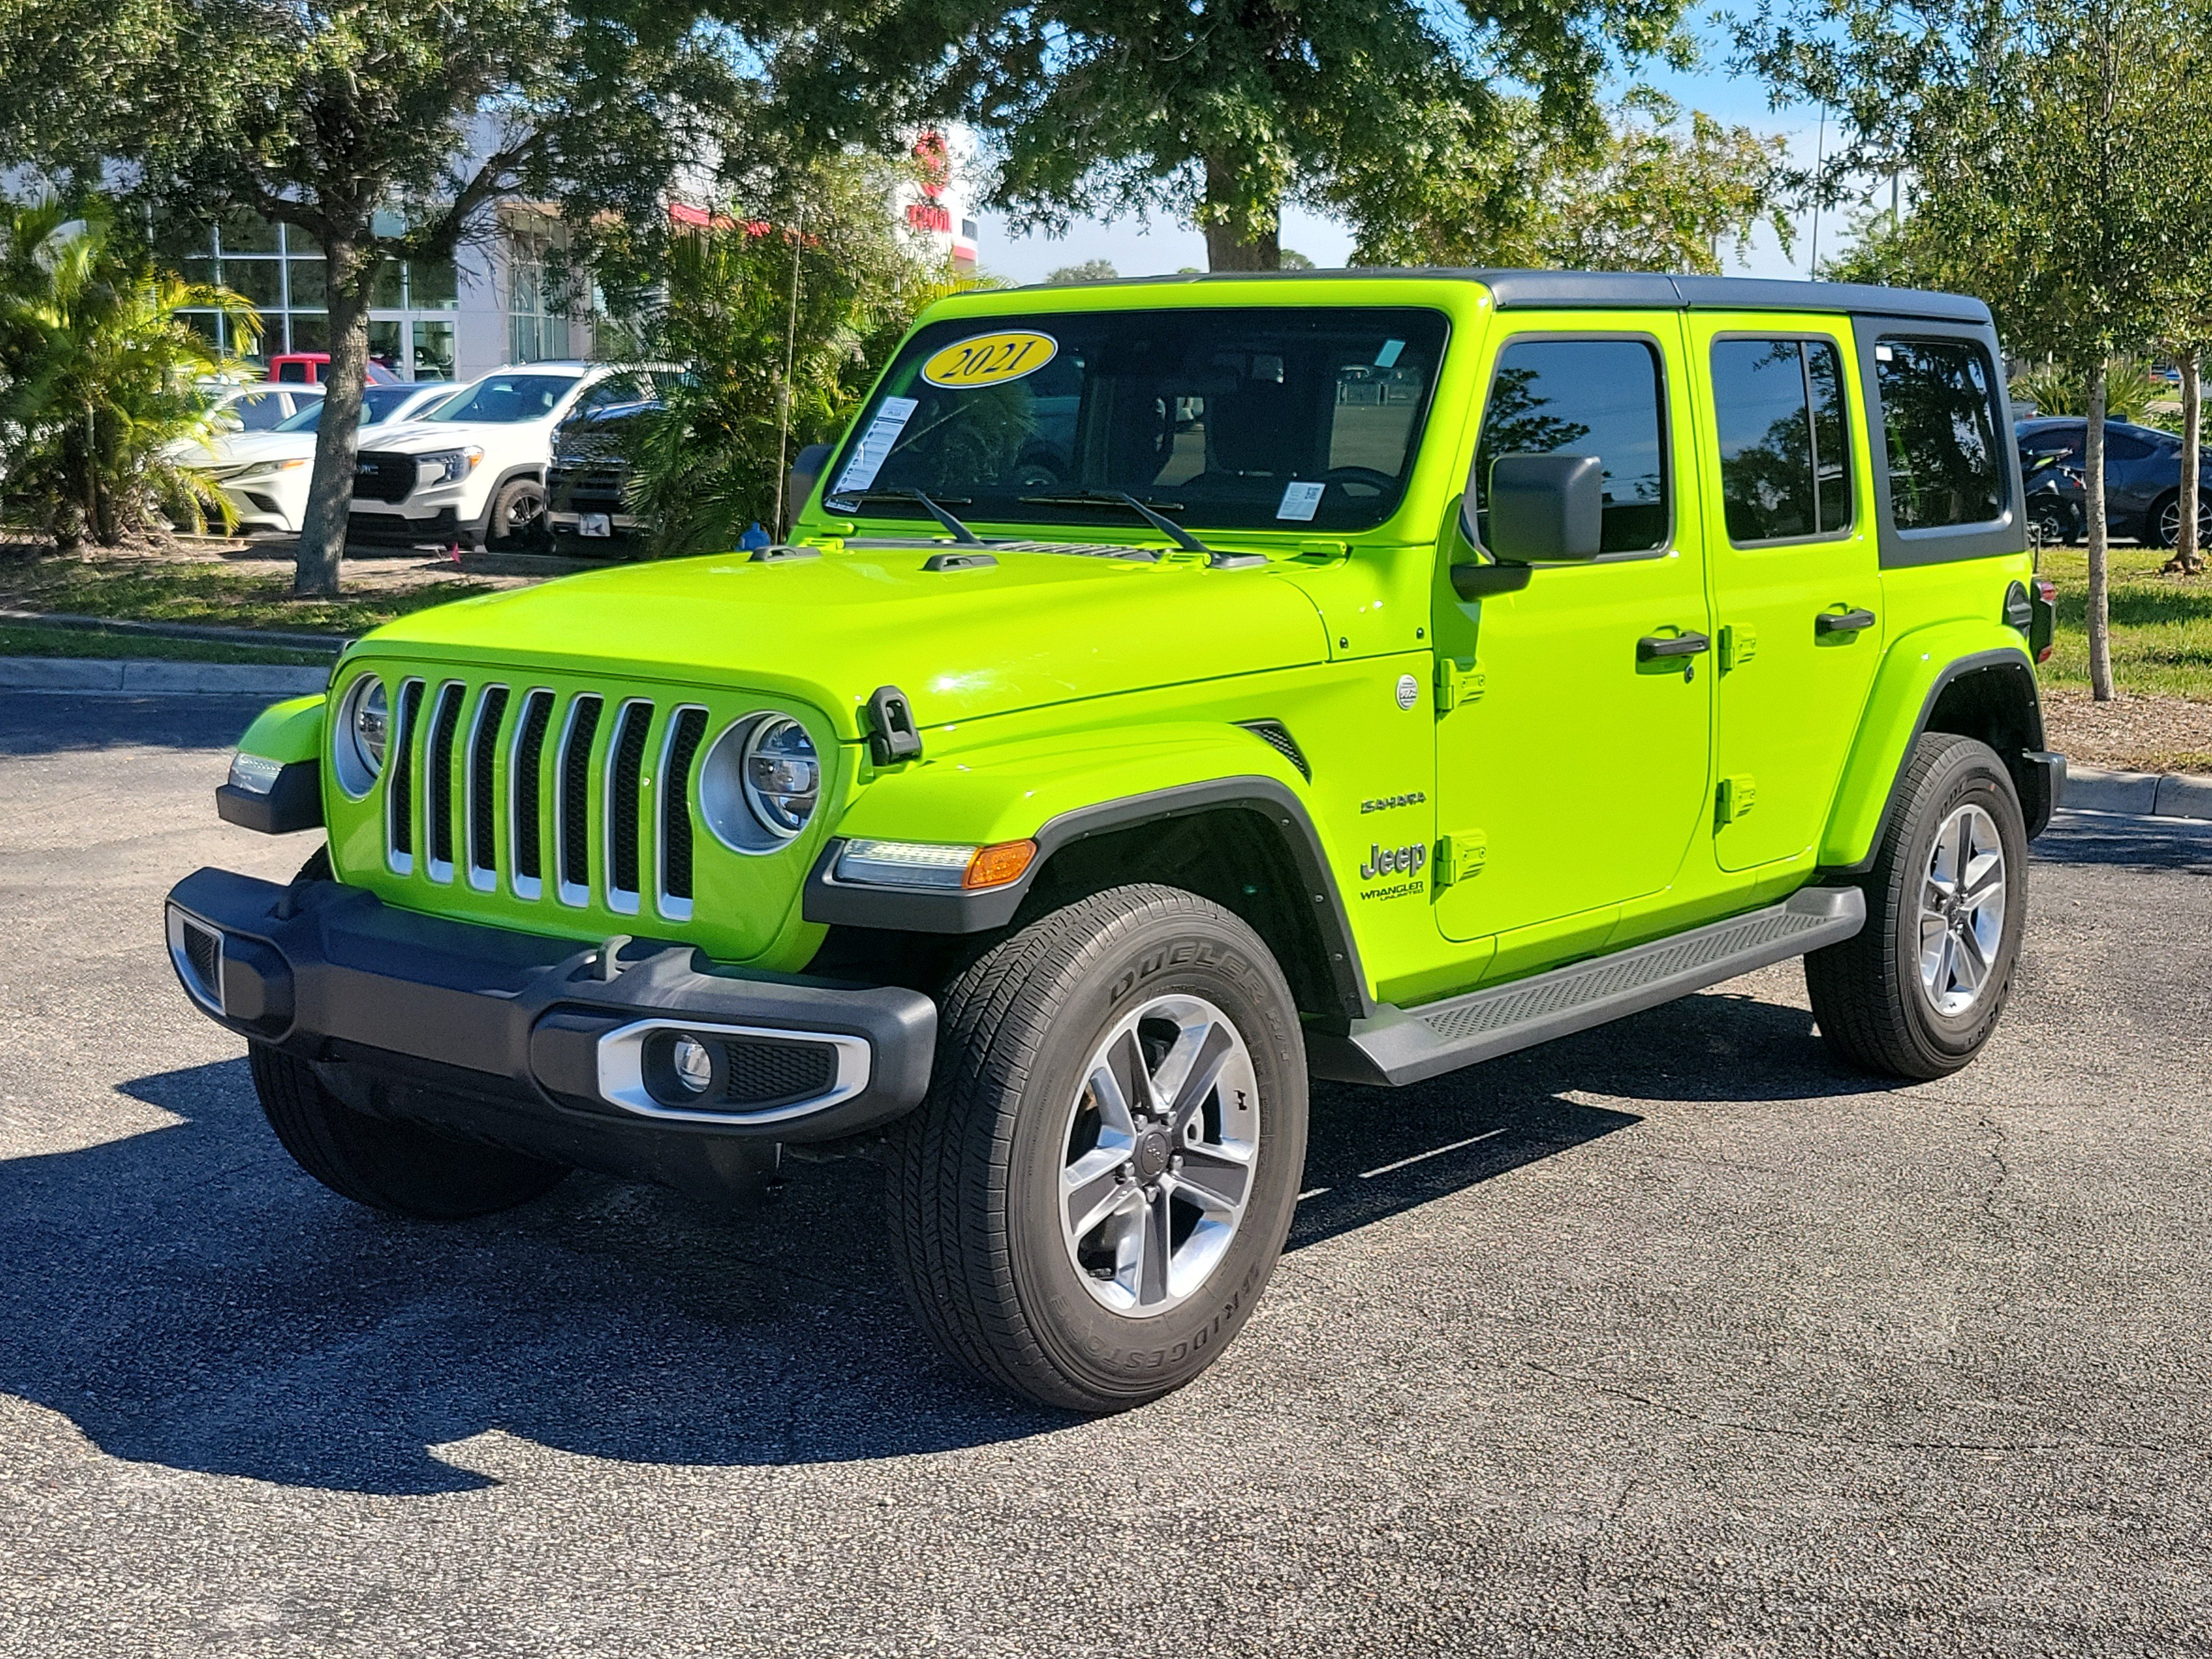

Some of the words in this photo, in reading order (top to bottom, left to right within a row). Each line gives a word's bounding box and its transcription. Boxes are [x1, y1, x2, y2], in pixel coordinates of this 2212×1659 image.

[939, 339, 1038, 379] 2021
[357, 465, 379, 475] MC
[1360, 791, 1427, 815] SAHARA
[1360, 843, 1427, 880] Jeep
[1360, 881, 1424, 900] WRANGLER
[1380, 888, 1424, 901] UNLIMITED
[1108, 941, 1269, 1007] DUELER
